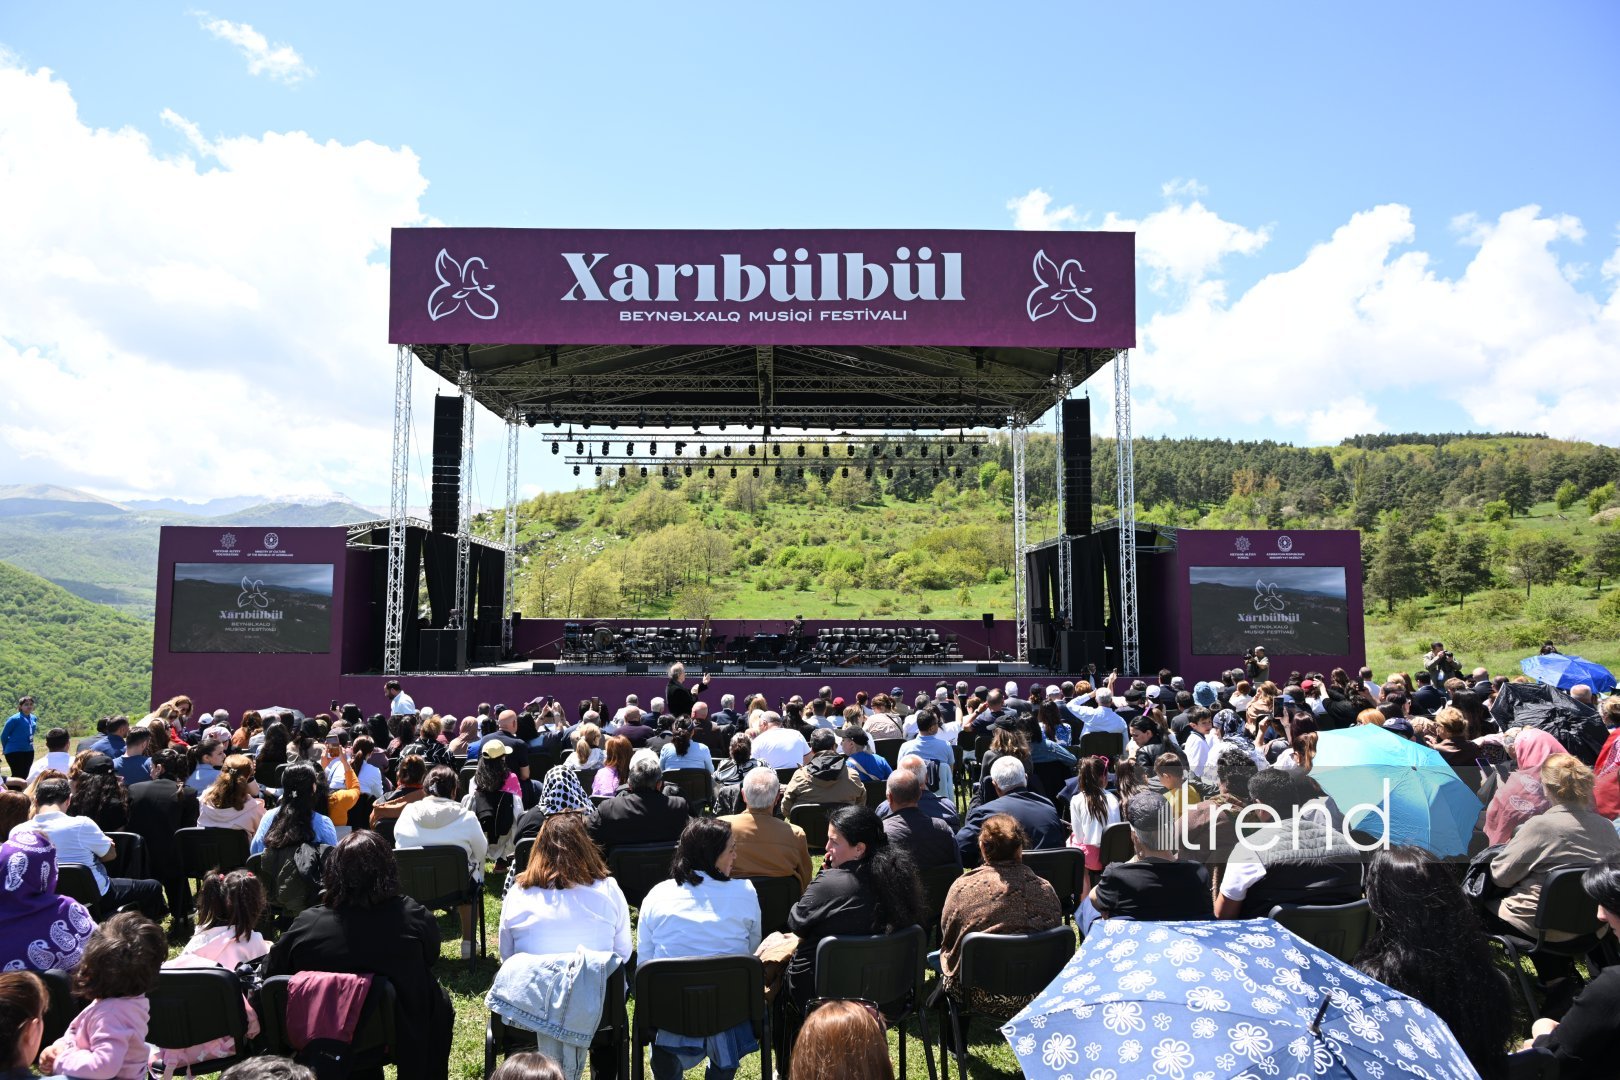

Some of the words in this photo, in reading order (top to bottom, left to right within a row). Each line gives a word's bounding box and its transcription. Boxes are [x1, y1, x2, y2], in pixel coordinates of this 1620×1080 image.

[560, 247, 966, 302] Xarıbülbül
[619, 311, 741, 322] BEYNƏLXALQ
[749, 308, 812, 322] MUSİQİ
[820, 308, 907, 321] FESTİVALI
